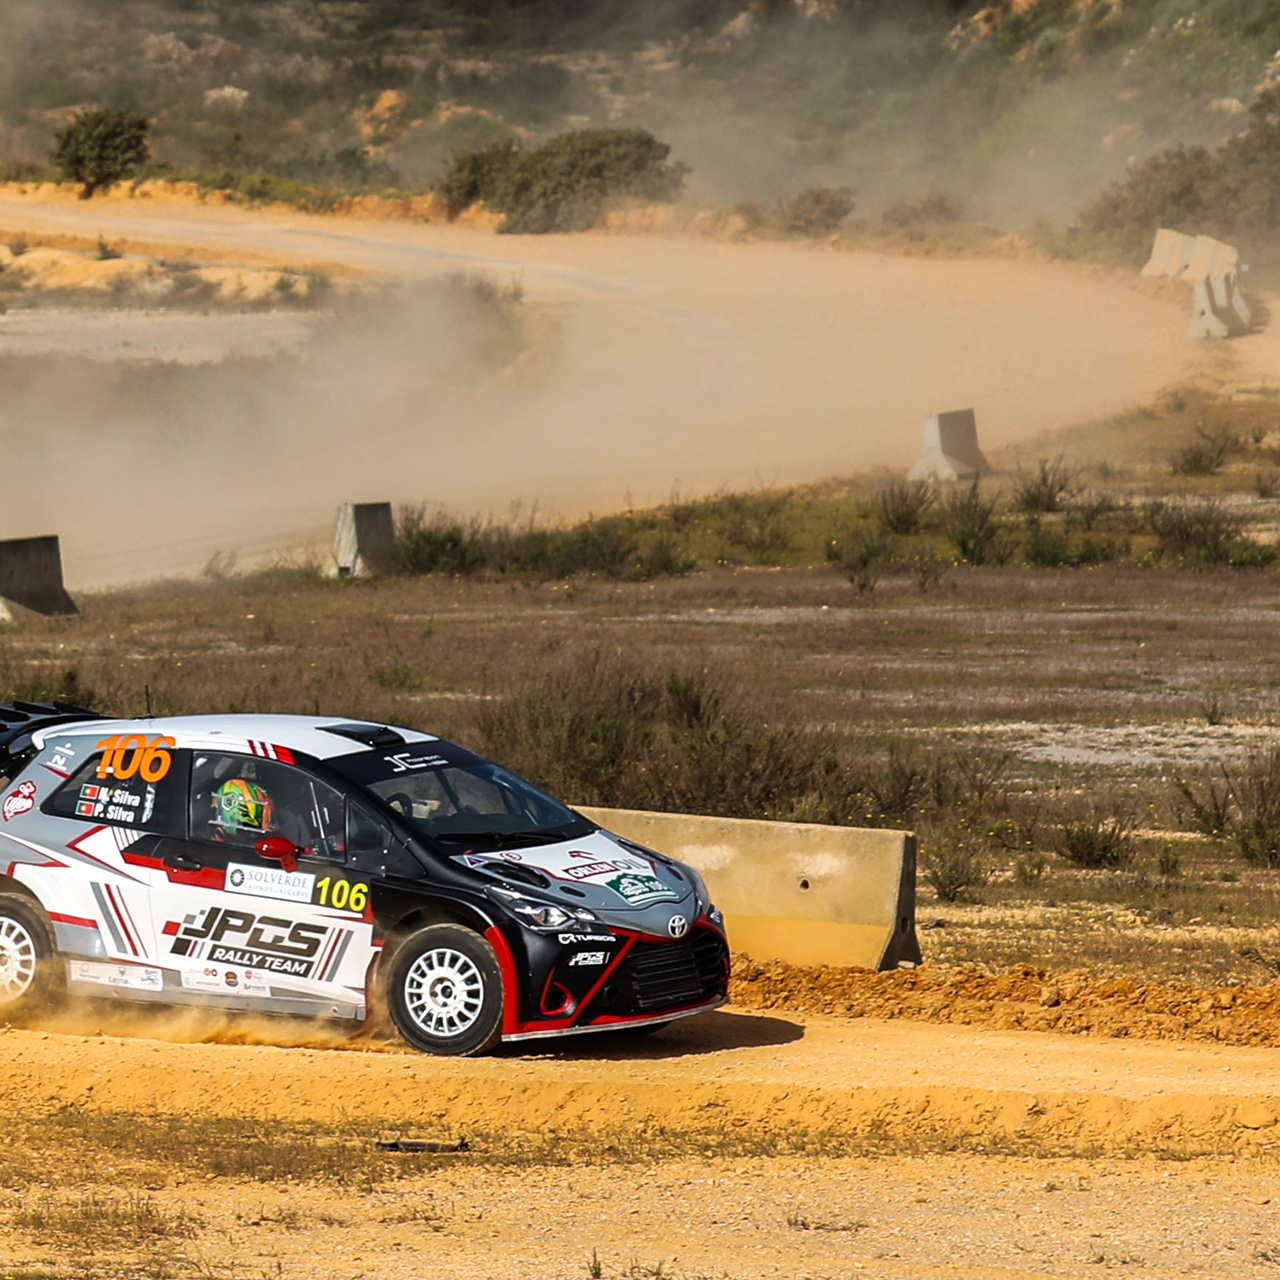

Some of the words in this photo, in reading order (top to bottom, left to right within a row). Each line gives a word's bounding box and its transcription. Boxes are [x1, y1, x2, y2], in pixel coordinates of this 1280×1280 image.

[95, 734, 176, 783] 106
[98, 787, 111, 802] N.
[113, 788, 141, 807] Silva
[93, 805, 104, 818] P.
[106, 805, 135, 823] Silva
[568, 862, 616, 879] ORLEN
[613, 858, 649, 871] OIL
[248, 870, 309, 889] SOLVERDE
[316, 876, 369, 912] 106
[576, 934, 616, 942] TURBOS
[213, 947, 263, 966] RALLY
[264, 956, 308, 975] TEAM
